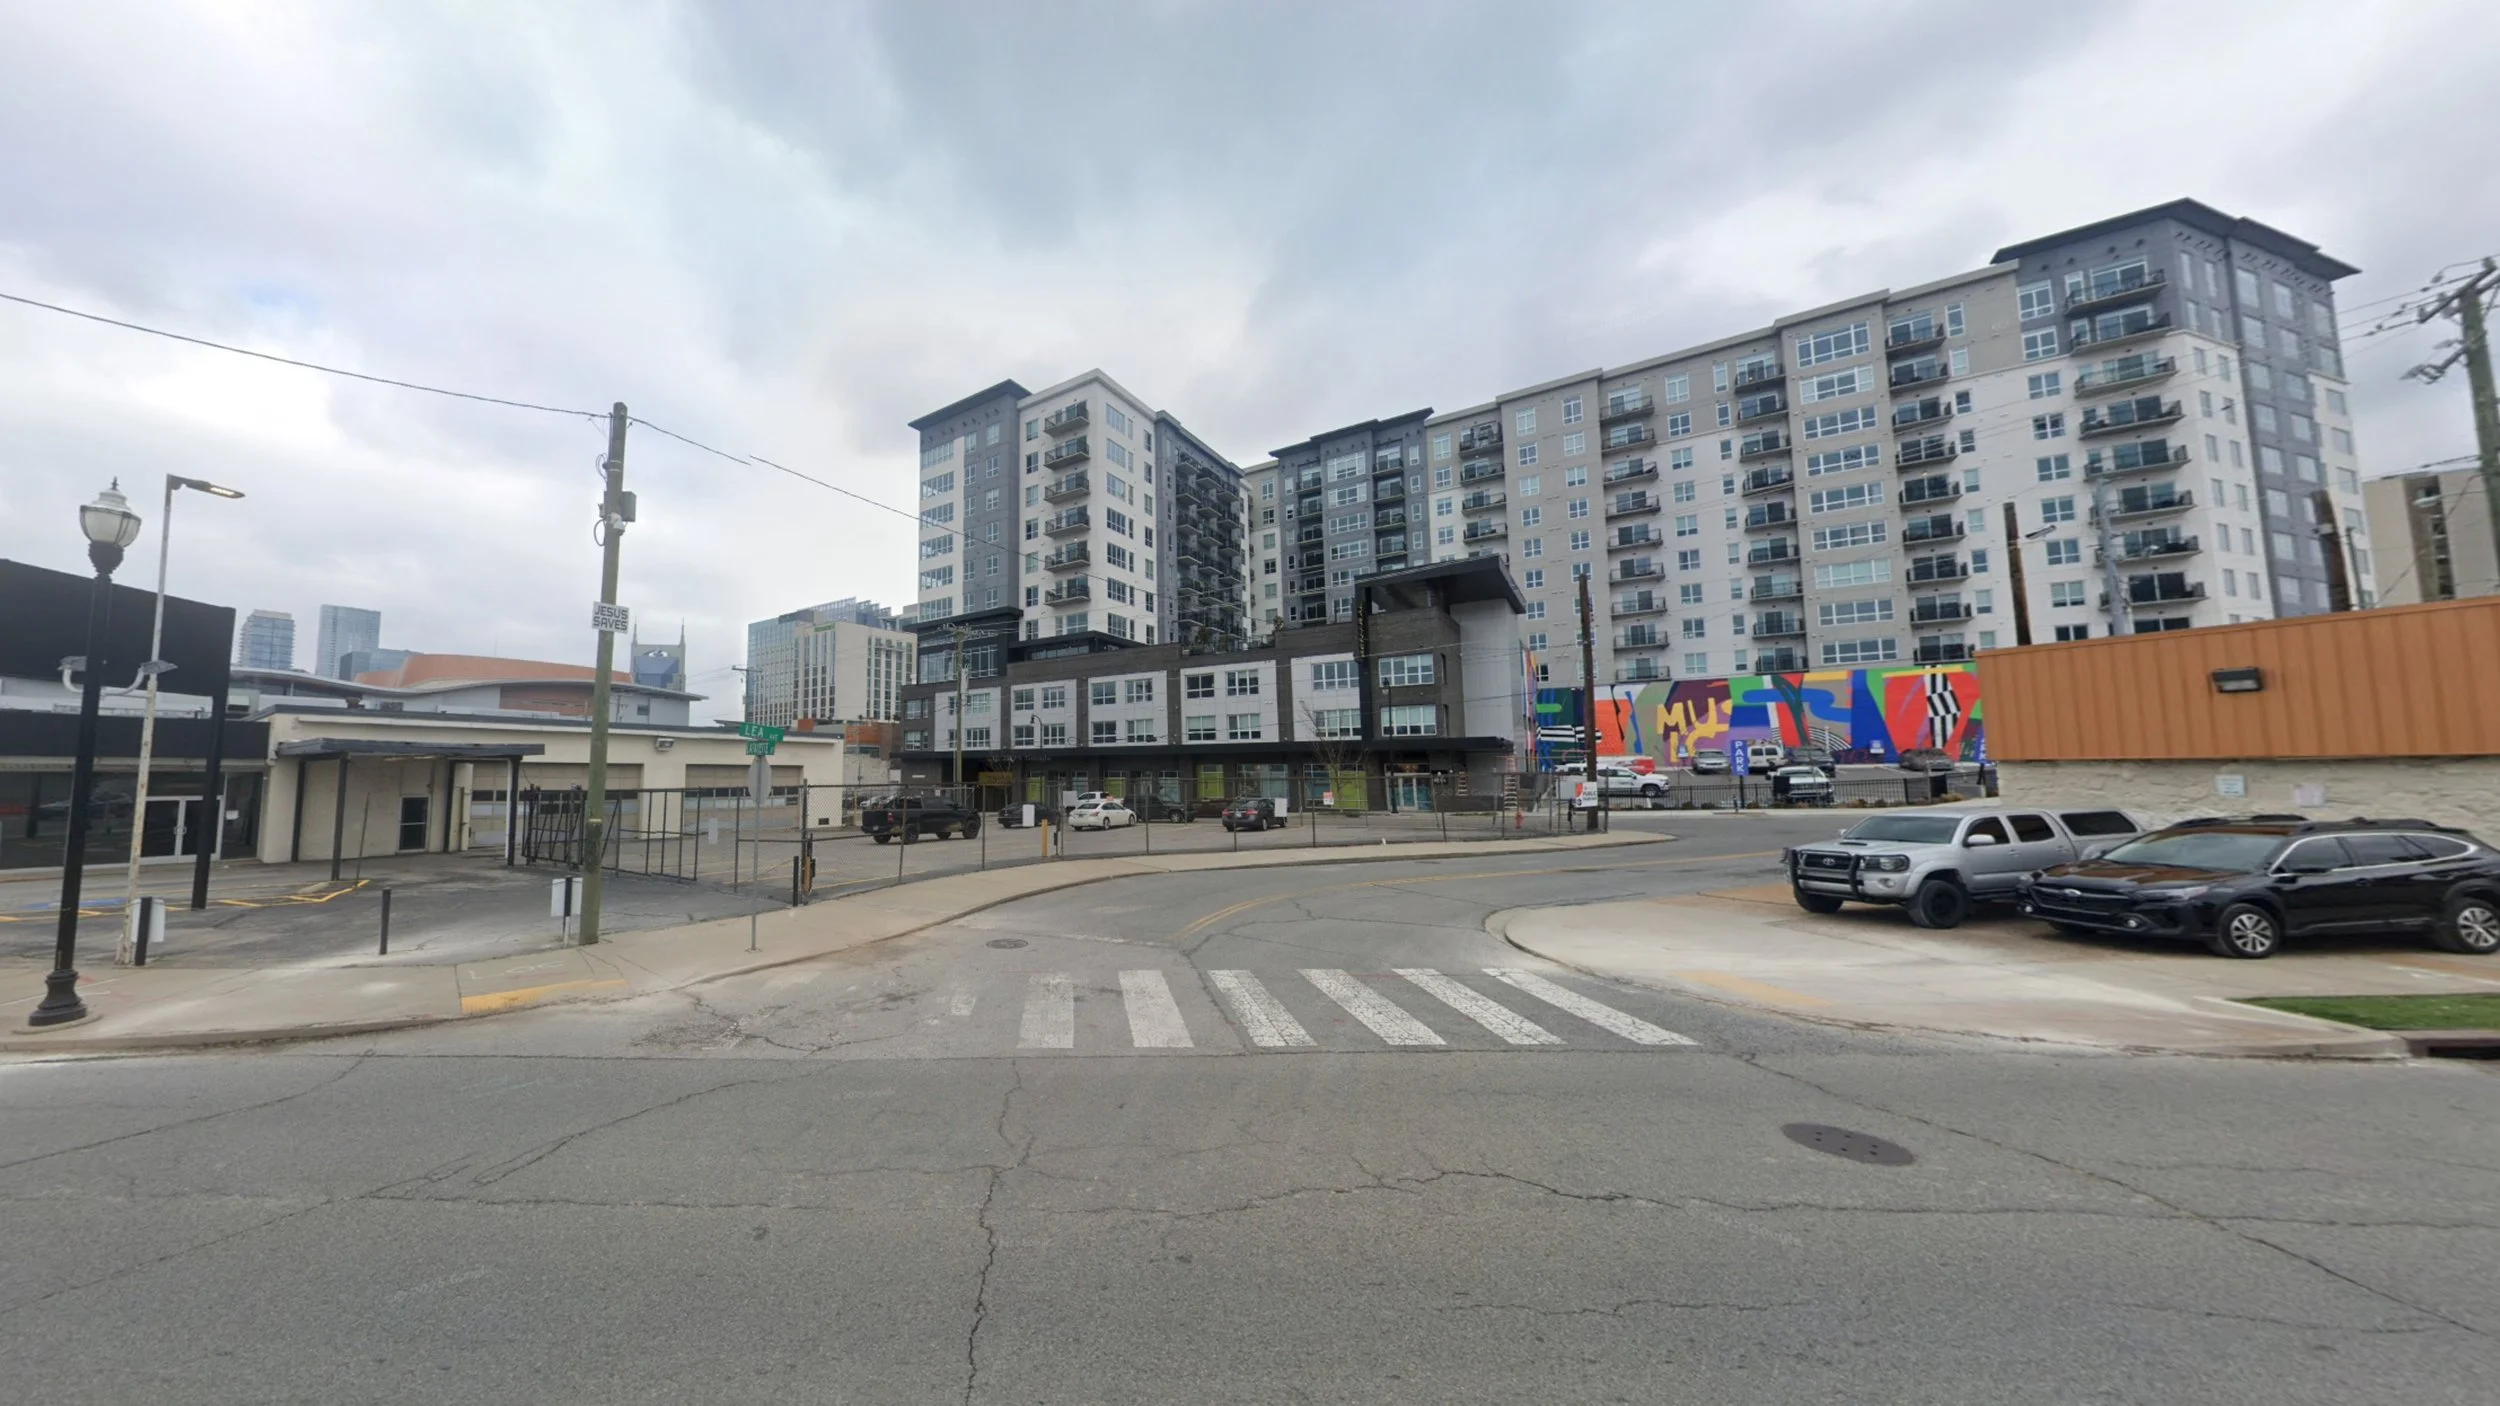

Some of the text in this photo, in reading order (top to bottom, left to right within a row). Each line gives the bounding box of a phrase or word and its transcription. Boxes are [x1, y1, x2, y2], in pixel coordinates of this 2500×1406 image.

[594, 604, 629, 620] JESUS
[593, 616, 628, 631] SAVES
[745, 724, 764, 738] LEA
[1734, 740, 1745, 773] PARK
